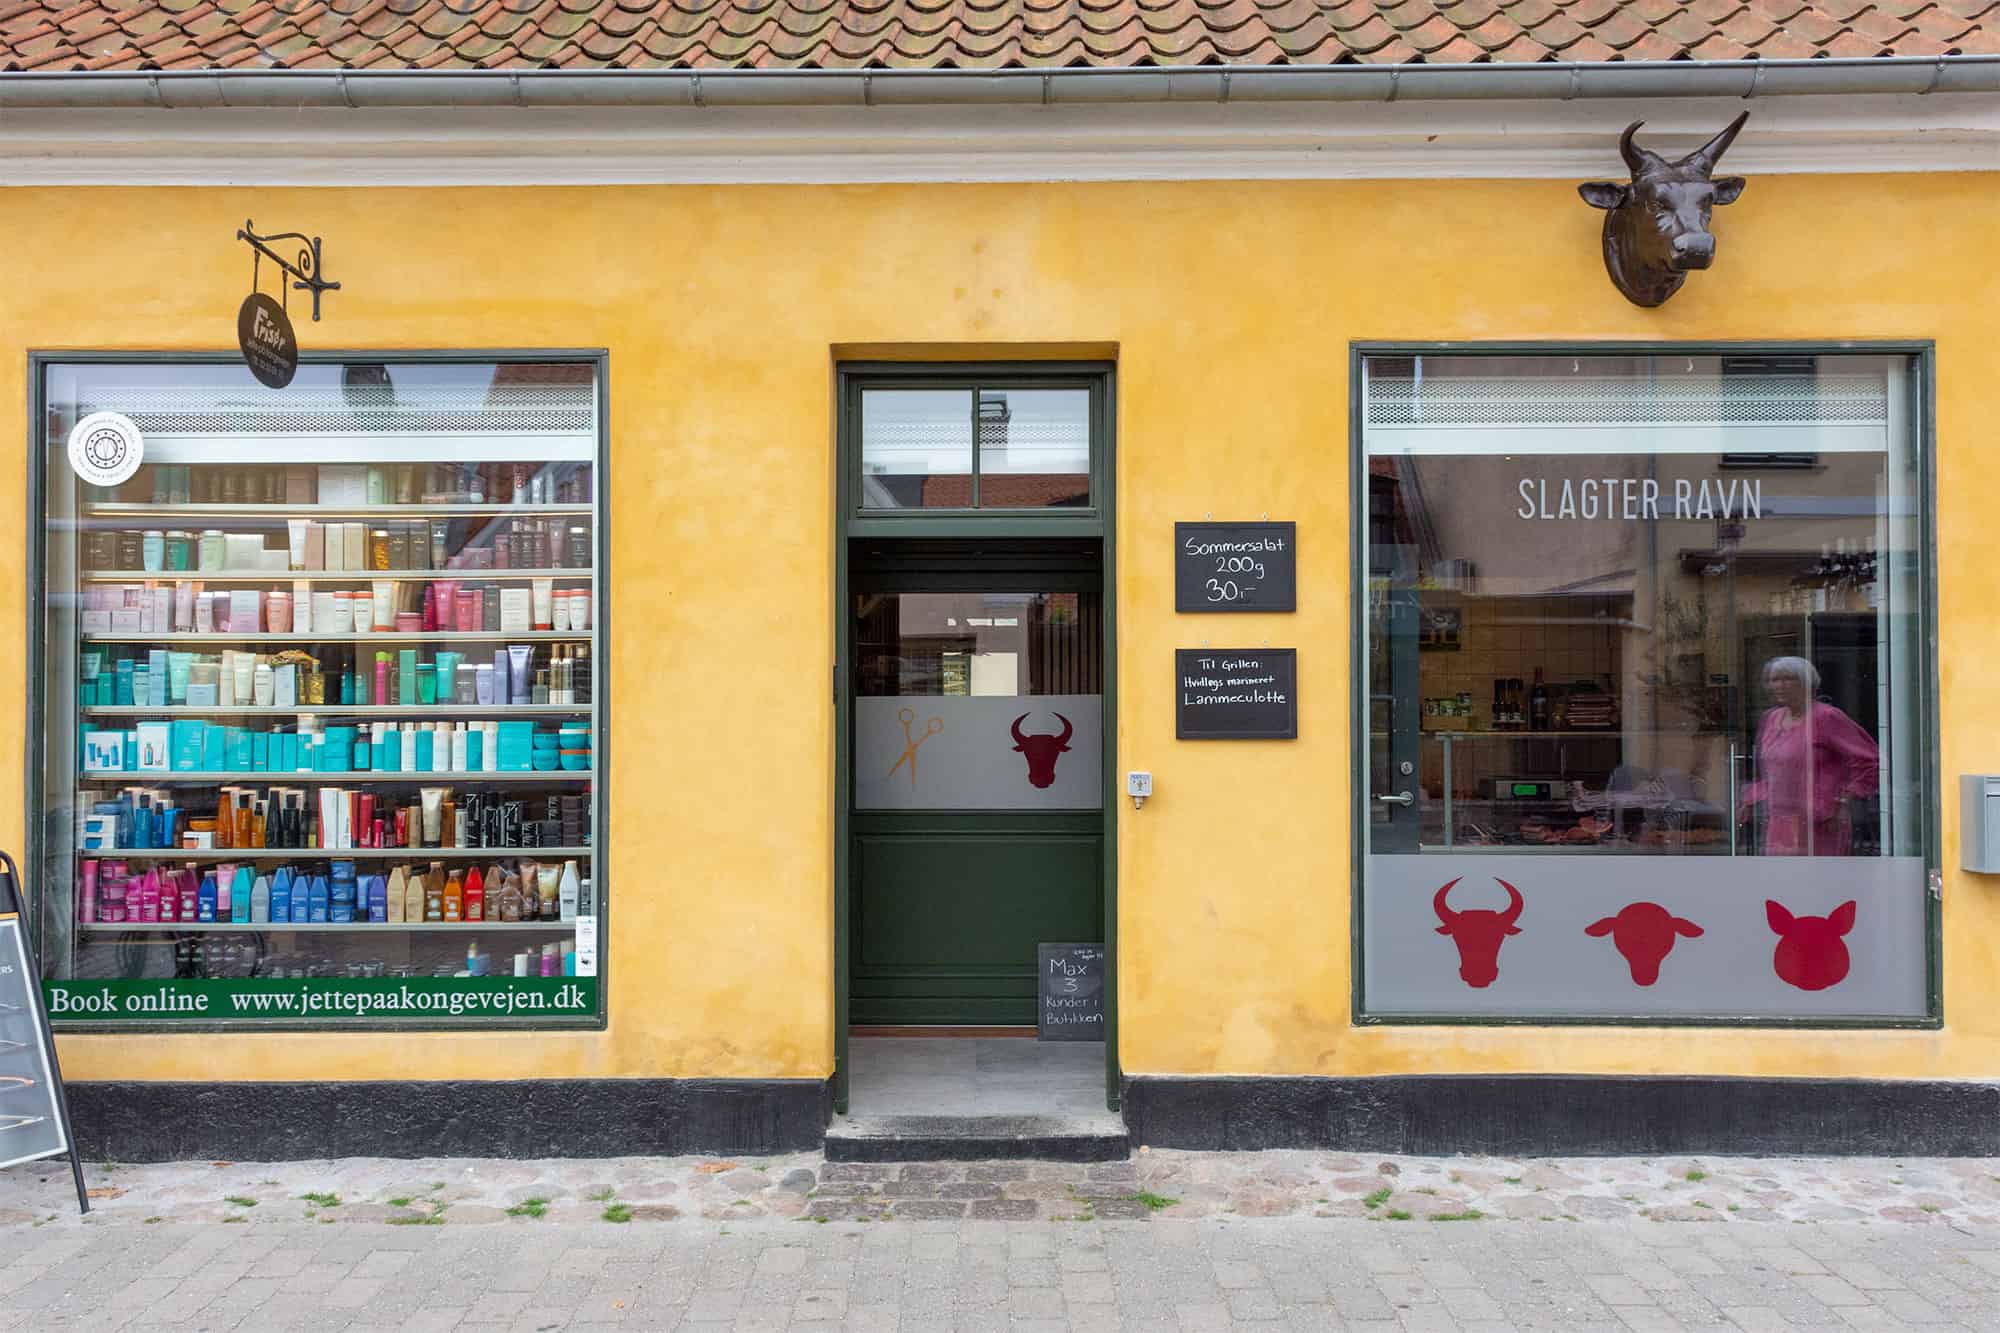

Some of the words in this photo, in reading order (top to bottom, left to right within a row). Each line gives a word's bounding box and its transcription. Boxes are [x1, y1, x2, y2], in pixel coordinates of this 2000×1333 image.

[1517, 479, 1659, 520] SLAGTER
[1675, 479, 1762, 520] RAVN
[1185, 536, 1286, 556] Sommersalat
[1215, 556, 1265, 580] 200g
[1197, 658, 1216, 670] Til
[1184, 688, 1287, 705] Lammeculotte
[1050, 958, 1088, 976] Max
[1063, 977, 1079, 993] 3
[50, 988, 118, 1013] Book
[126, 987, 209, 1013] online
[230, 984, 587, 1015] www.jettepaakongevejen.dk
[1046, 995, 1088, 1008] Kunder
